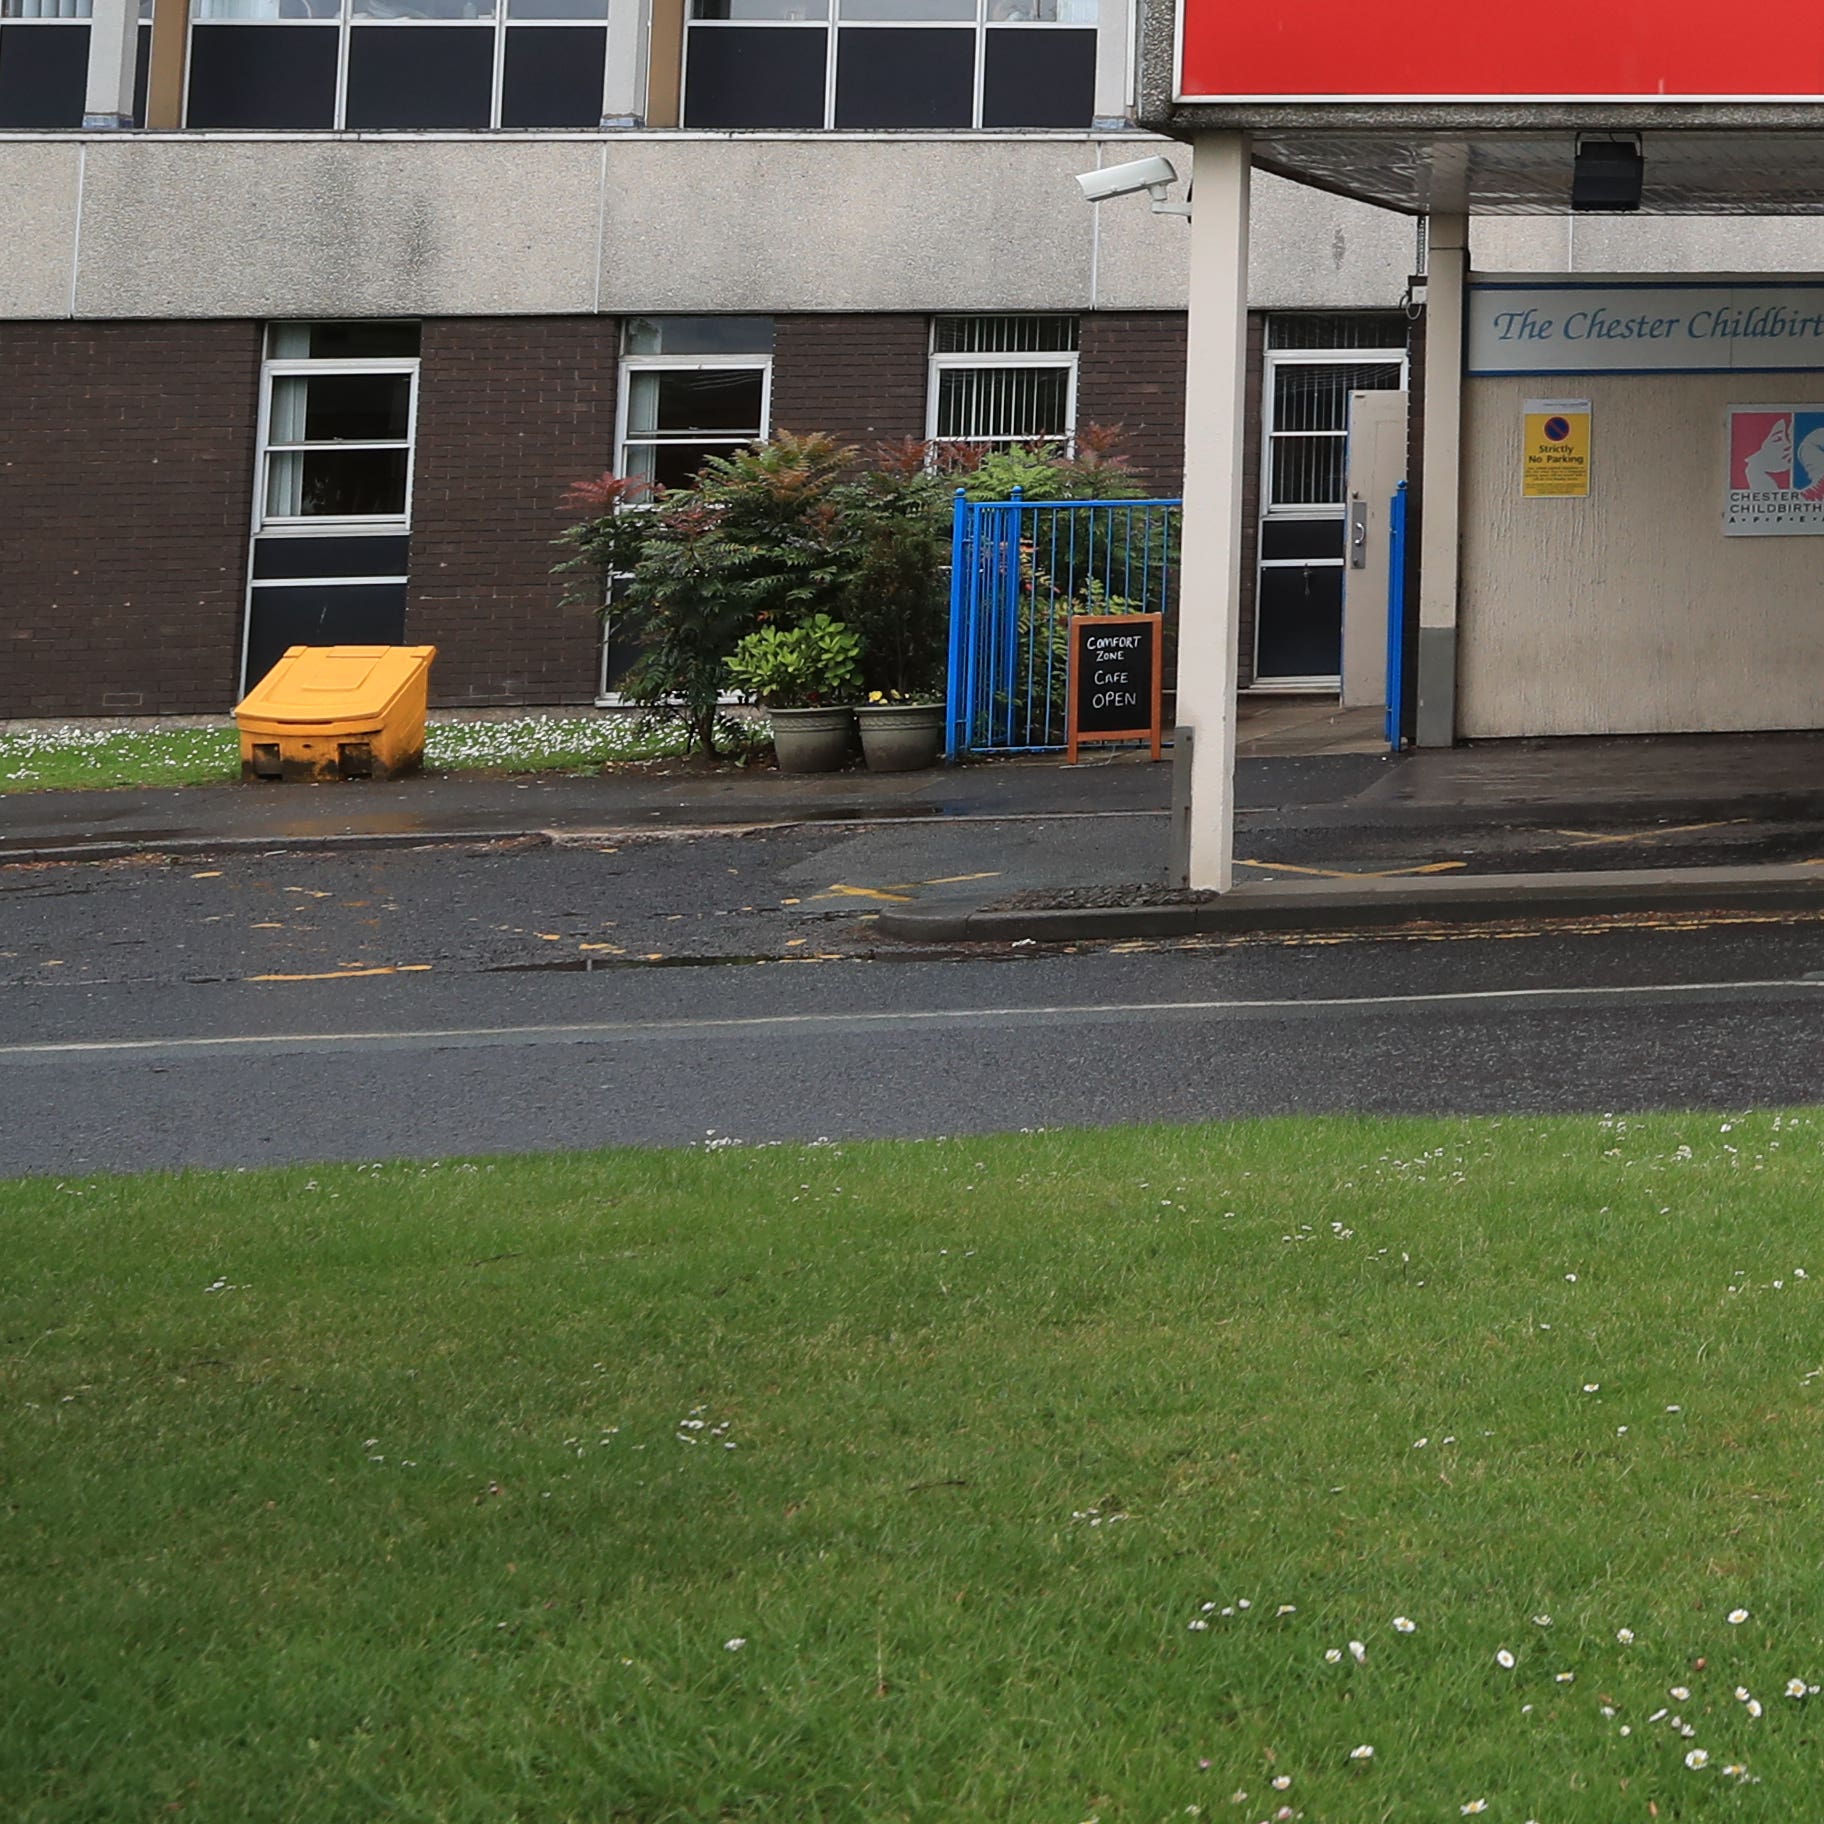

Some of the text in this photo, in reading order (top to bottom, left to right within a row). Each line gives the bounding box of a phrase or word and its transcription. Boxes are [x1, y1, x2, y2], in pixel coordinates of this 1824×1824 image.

[1493, 308, 1553, 340] The
[1563, 307, 1680, 340] Chester
[1539, 444, 1574, 456] Strictly
[1528, 455, 1584, 466] No Parking
[1730, 491, 1800, 502] CHESTER
[1730, 503, 1822, 514] CHILDBIRTH
[1087, 635, 1142, 650] COMFORT
[1096, 650, 1124, 662] ZONE
[1094, 670, 1129, 685] CAFE
[1092, 691, 1137, 708] OPEN
